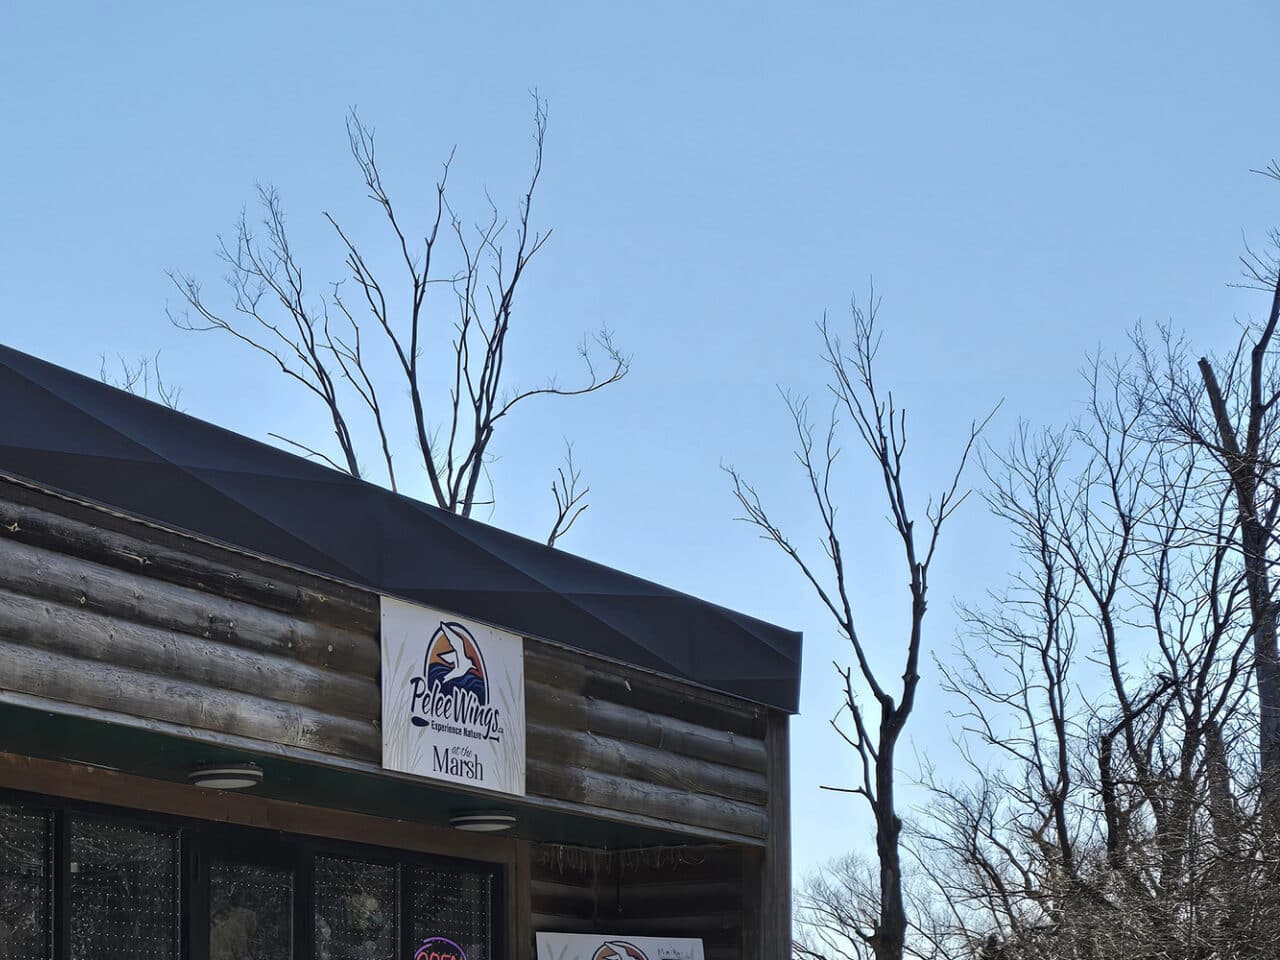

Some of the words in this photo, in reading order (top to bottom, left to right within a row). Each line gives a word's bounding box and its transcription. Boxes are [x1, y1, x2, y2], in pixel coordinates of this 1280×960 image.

[431, 720, 462, 736] Experience
[463, 728, 482, 740] Nature
[432, 745, 483, 781] Marsh
